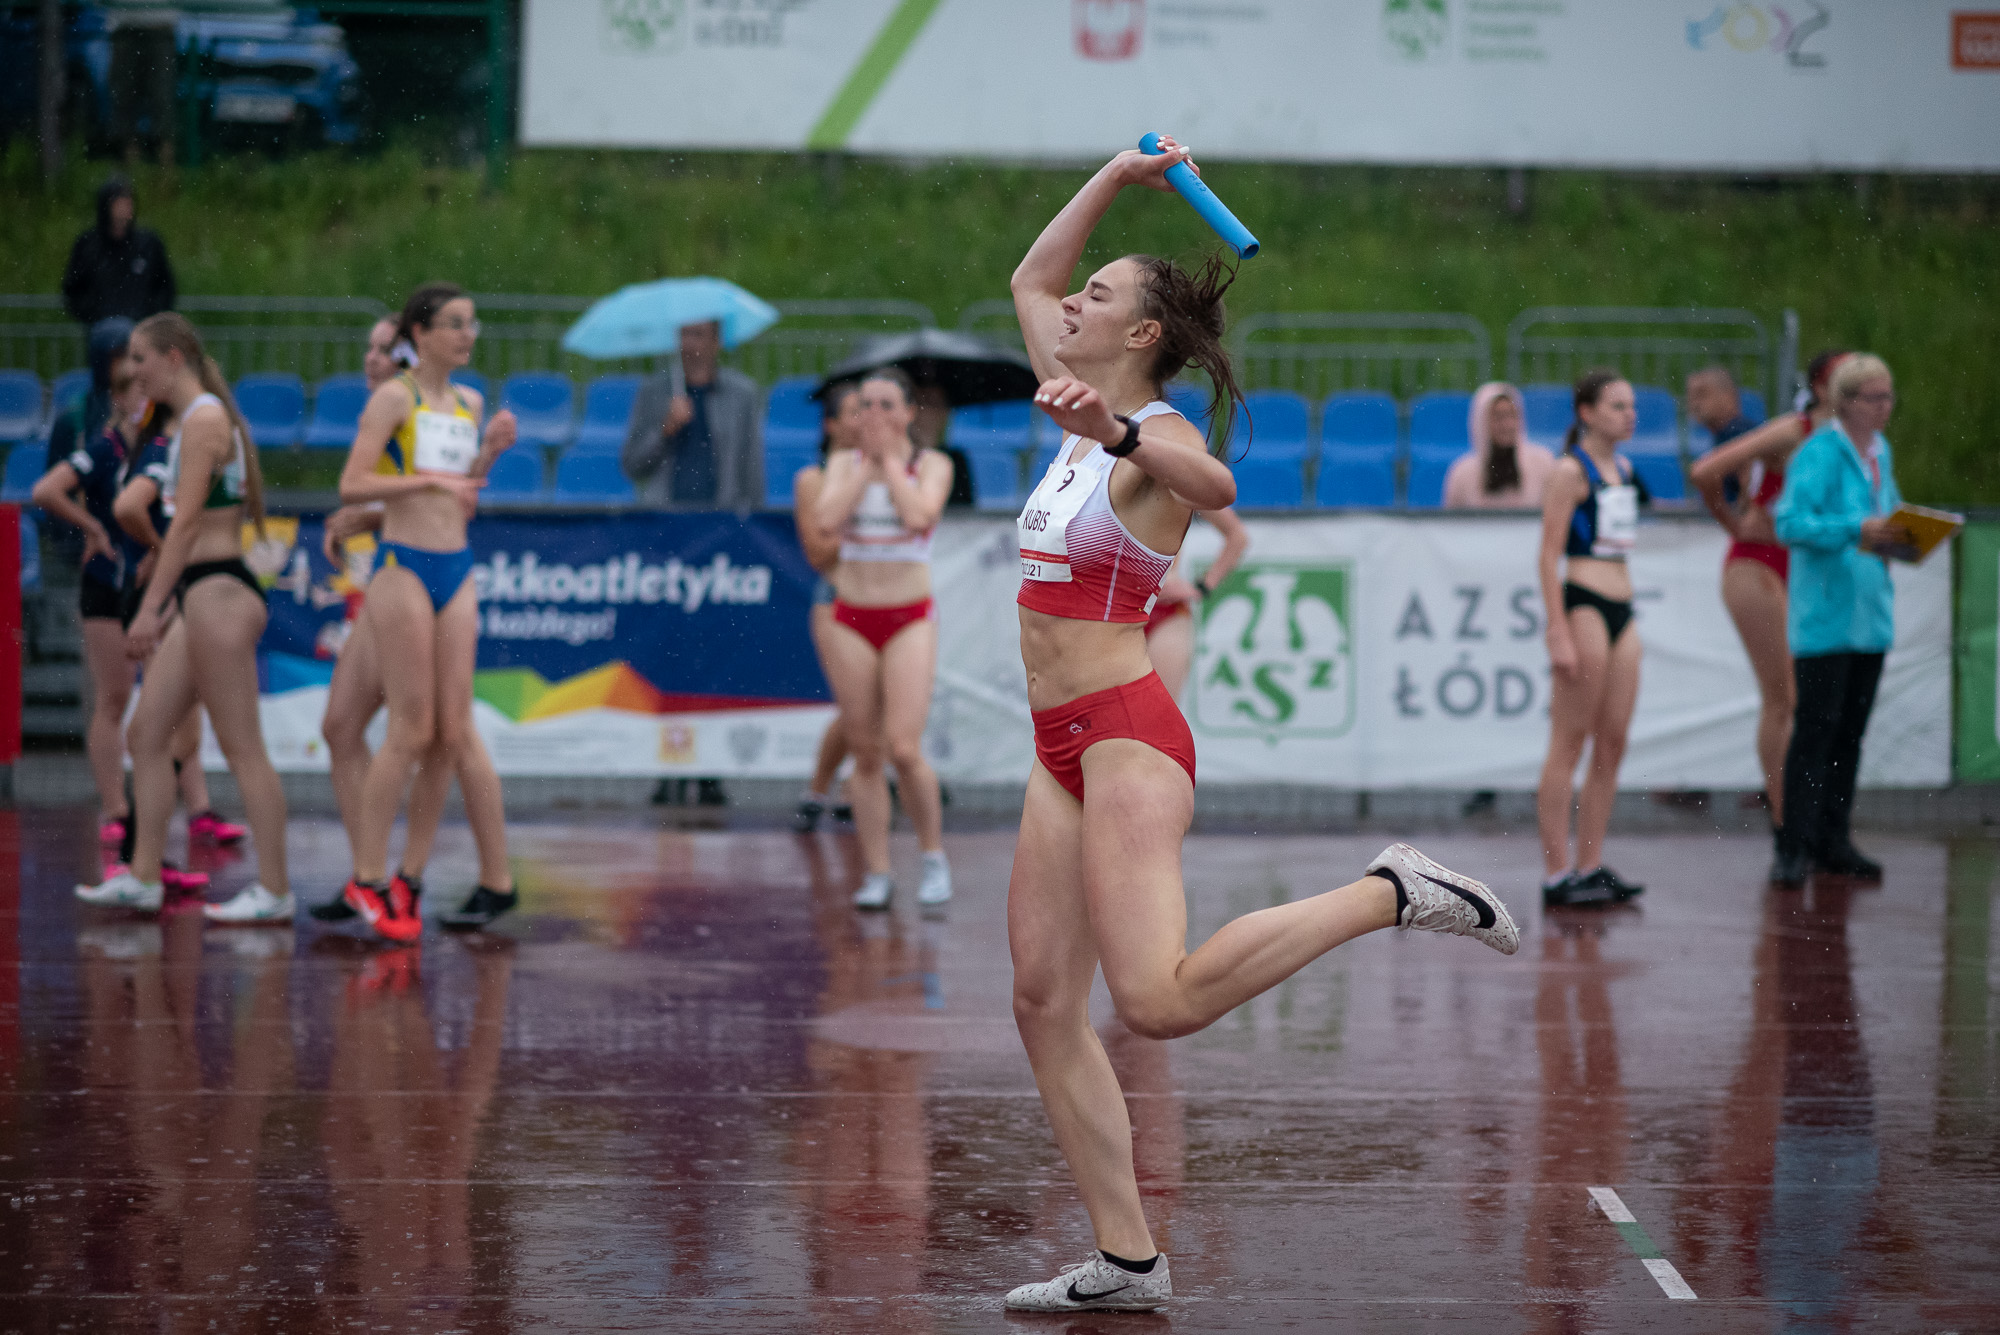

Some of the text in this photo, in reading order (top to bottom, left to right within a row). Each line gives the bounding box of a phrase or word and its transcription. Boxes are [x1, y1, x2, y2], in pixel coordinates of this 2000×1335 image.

[1056, 469, 1076, 493] 9
[1022, 509, 1051, 533] KUBIS
[1393, 651, 1552, 719] ŁÓD
